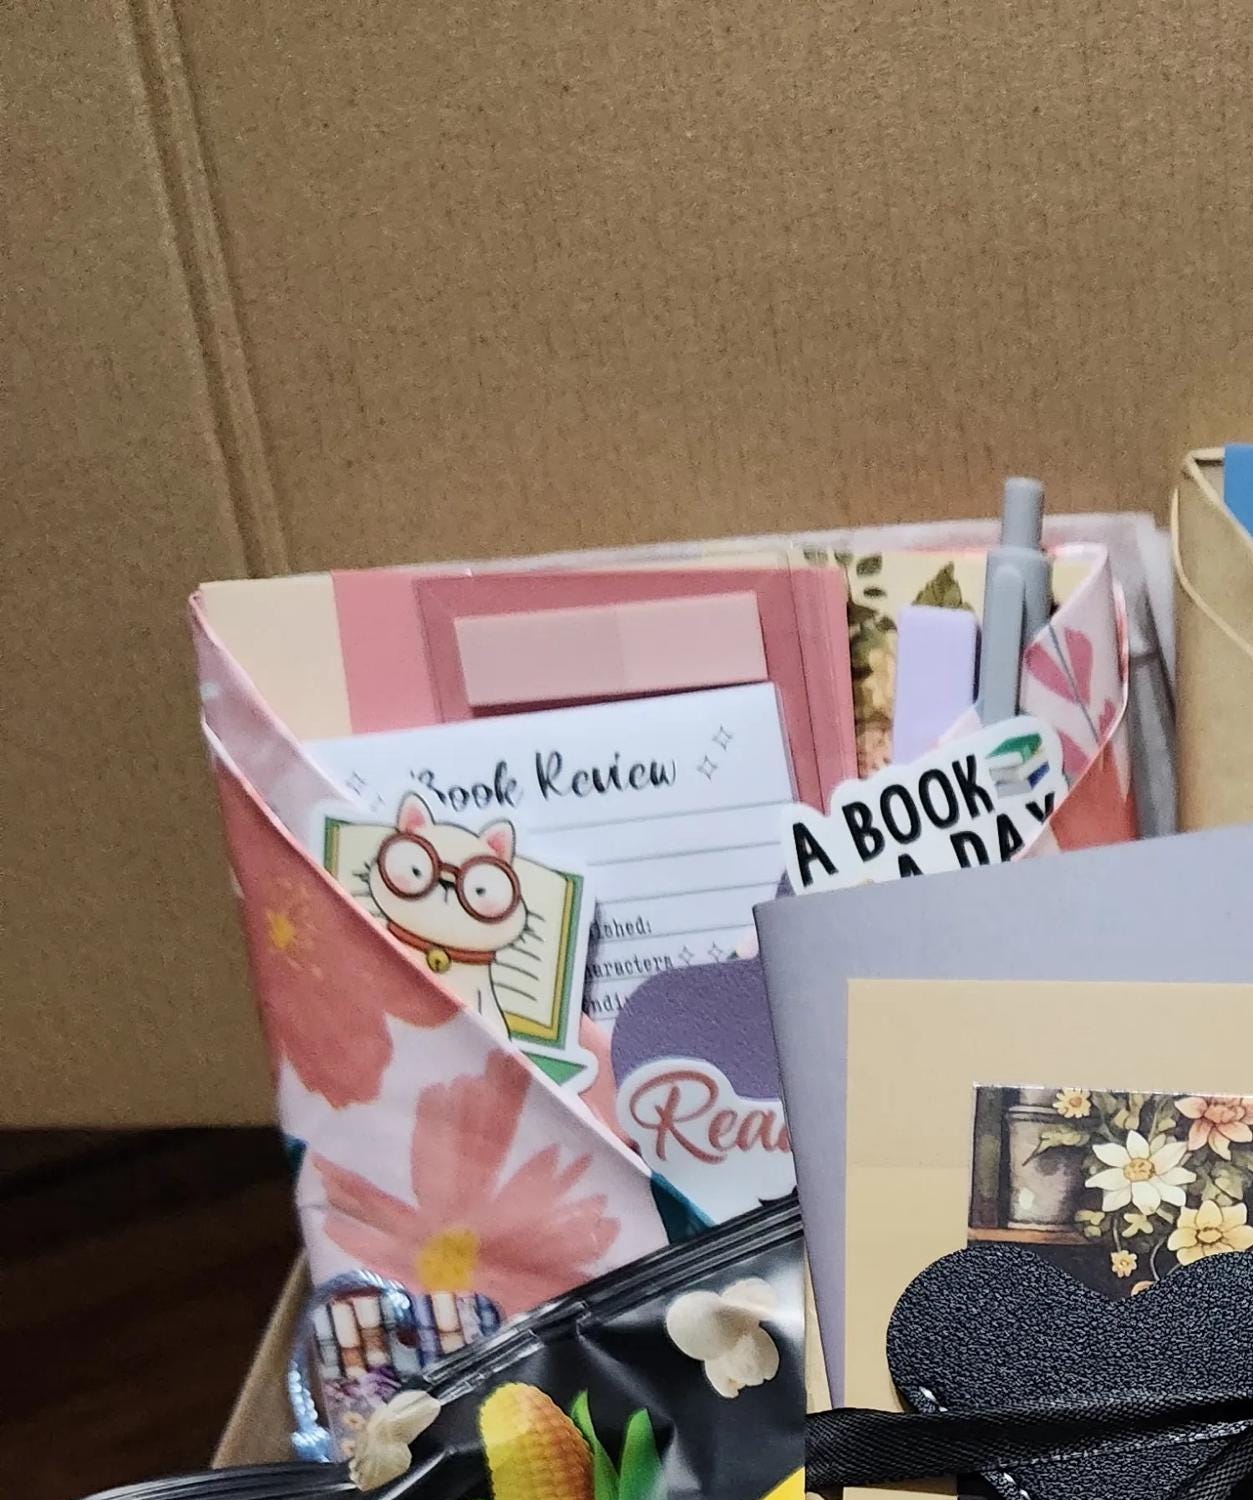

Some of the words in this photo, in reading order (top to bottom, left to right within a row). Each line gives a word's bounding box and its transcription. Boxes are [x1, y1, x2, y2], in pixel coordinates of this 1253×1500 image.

[534, 749, 678, 801] Review
[793, 822, 839, 887] A
[841, 754, 995, 863] BOOK
[629, 1070, 790, 1165] Rea
